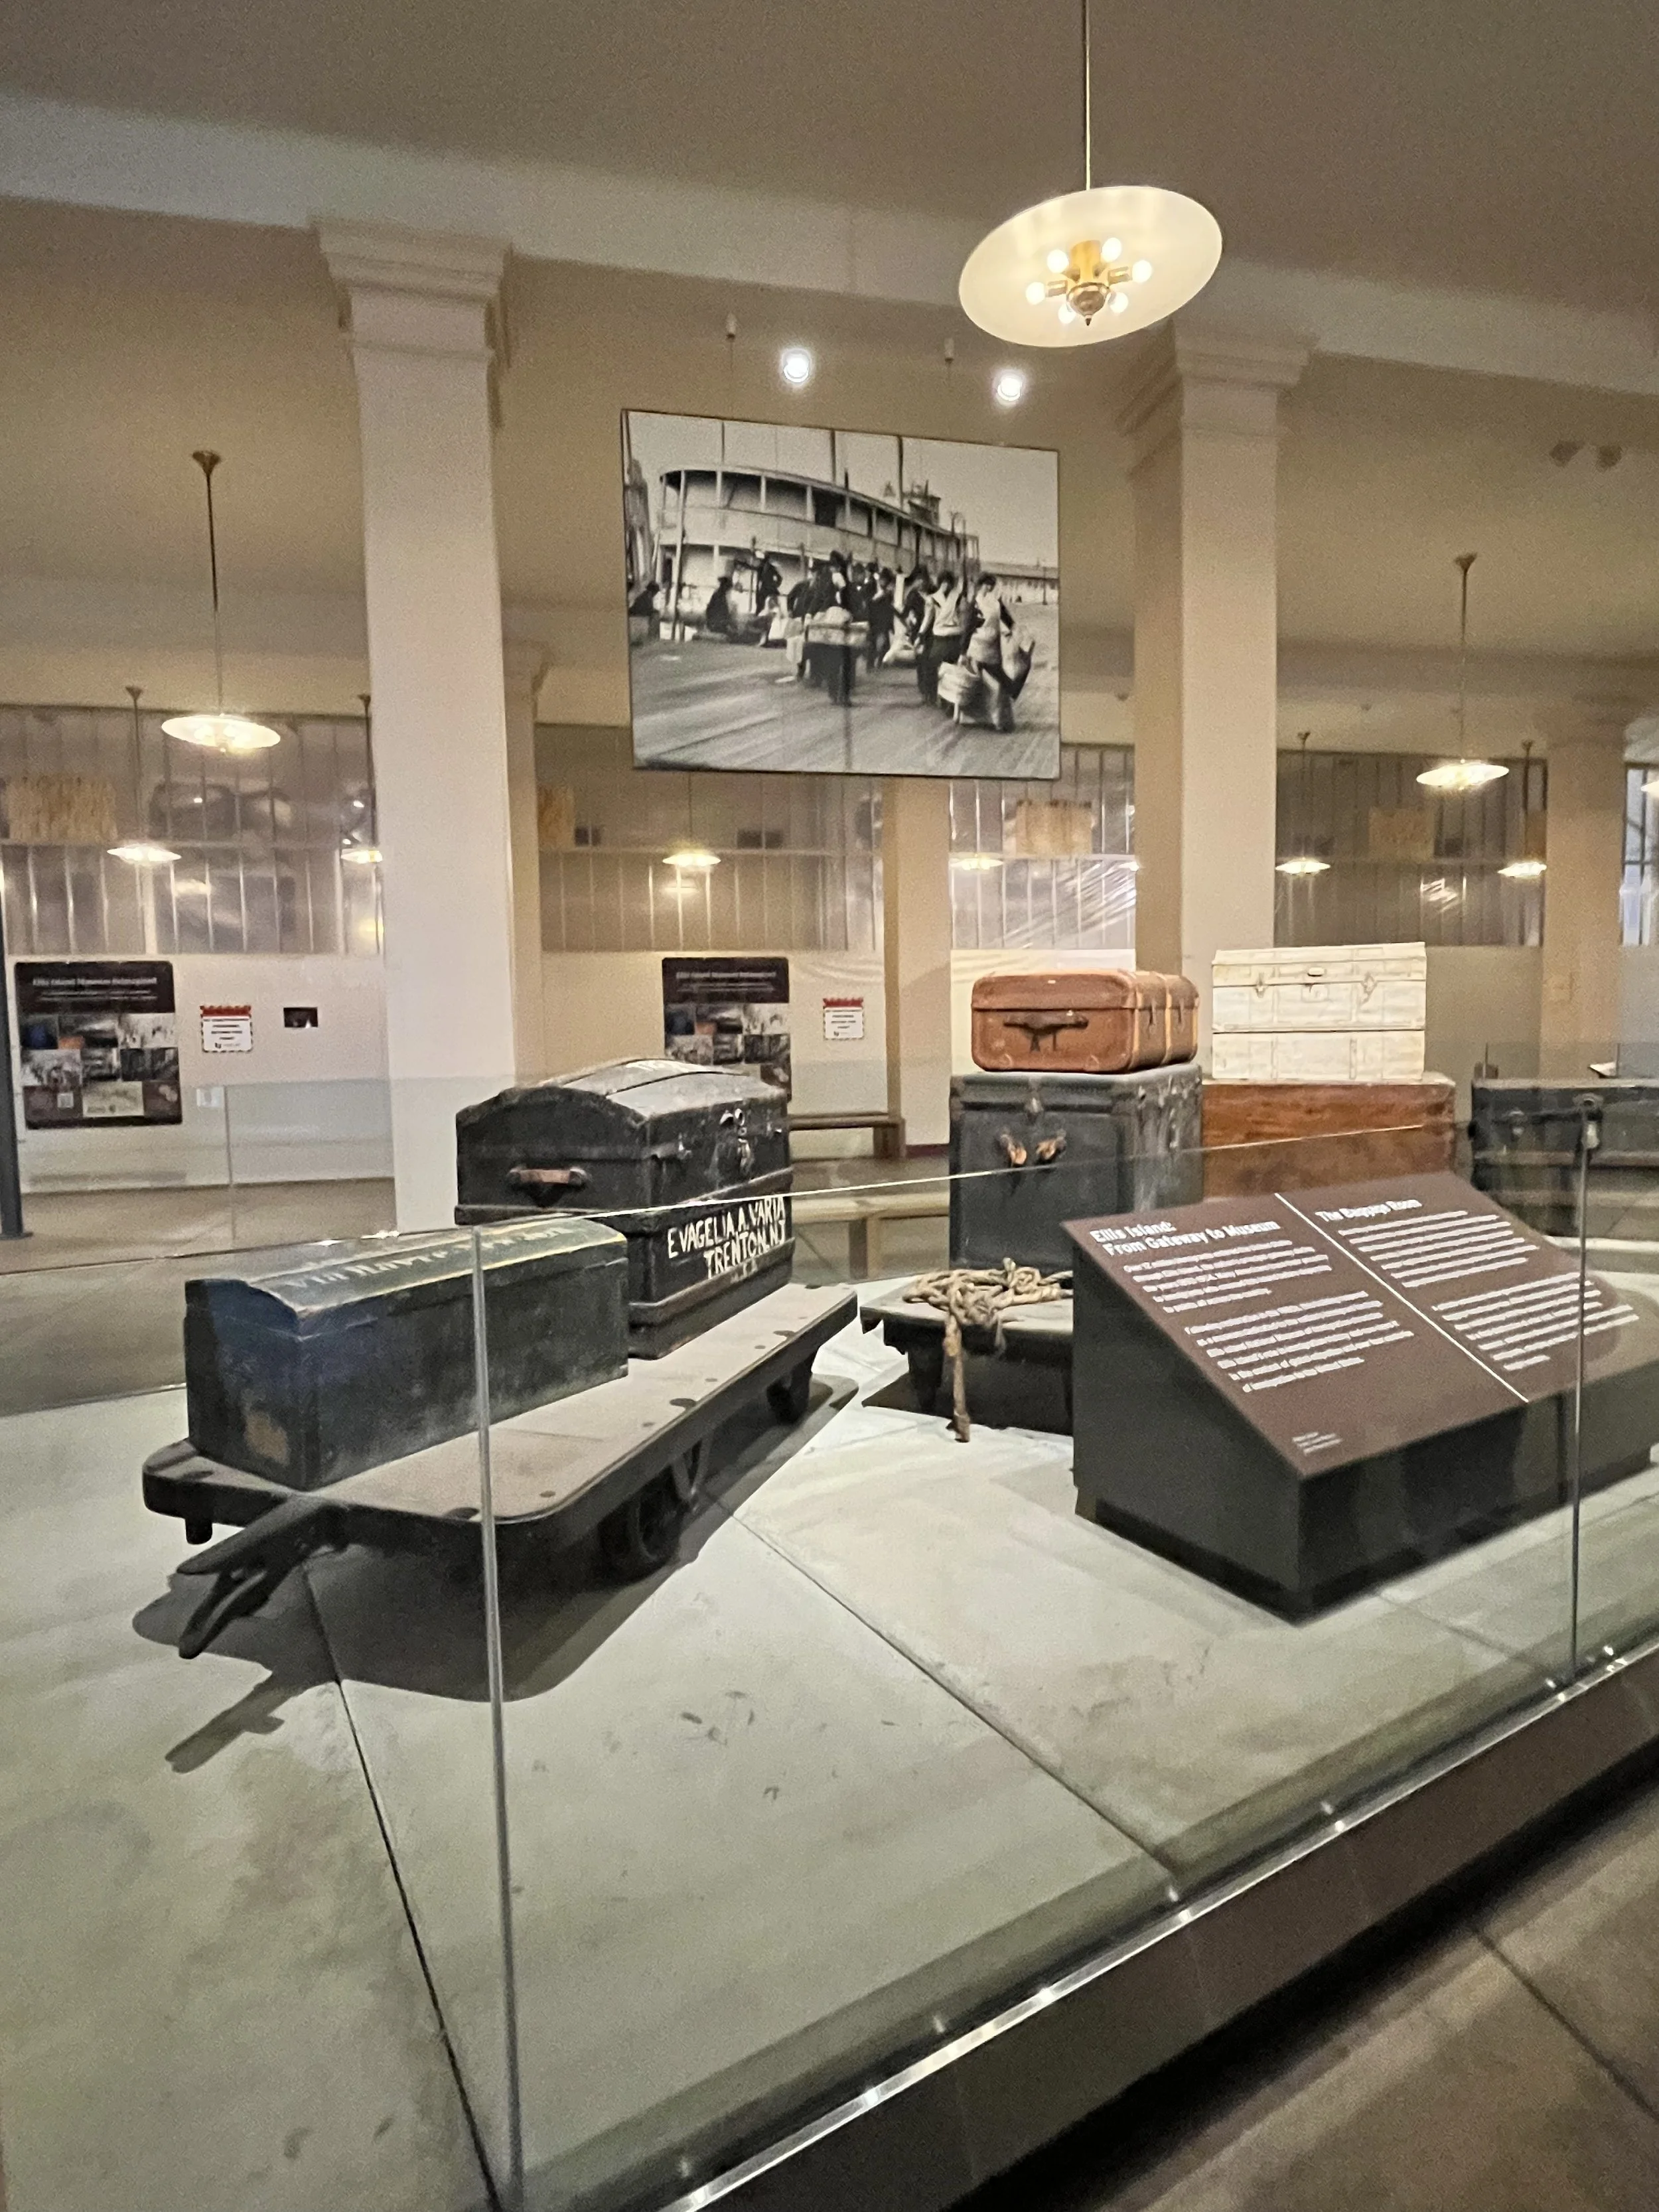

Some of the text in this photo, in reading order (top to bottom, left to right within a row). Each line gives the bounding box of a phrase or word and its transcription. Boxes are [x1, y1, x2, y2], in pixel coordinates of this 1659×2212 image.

[1090, 1221, 1177, 1243] Ellis Island:
[1102, 1220, 1281, 1256] From Gateway to Museum
